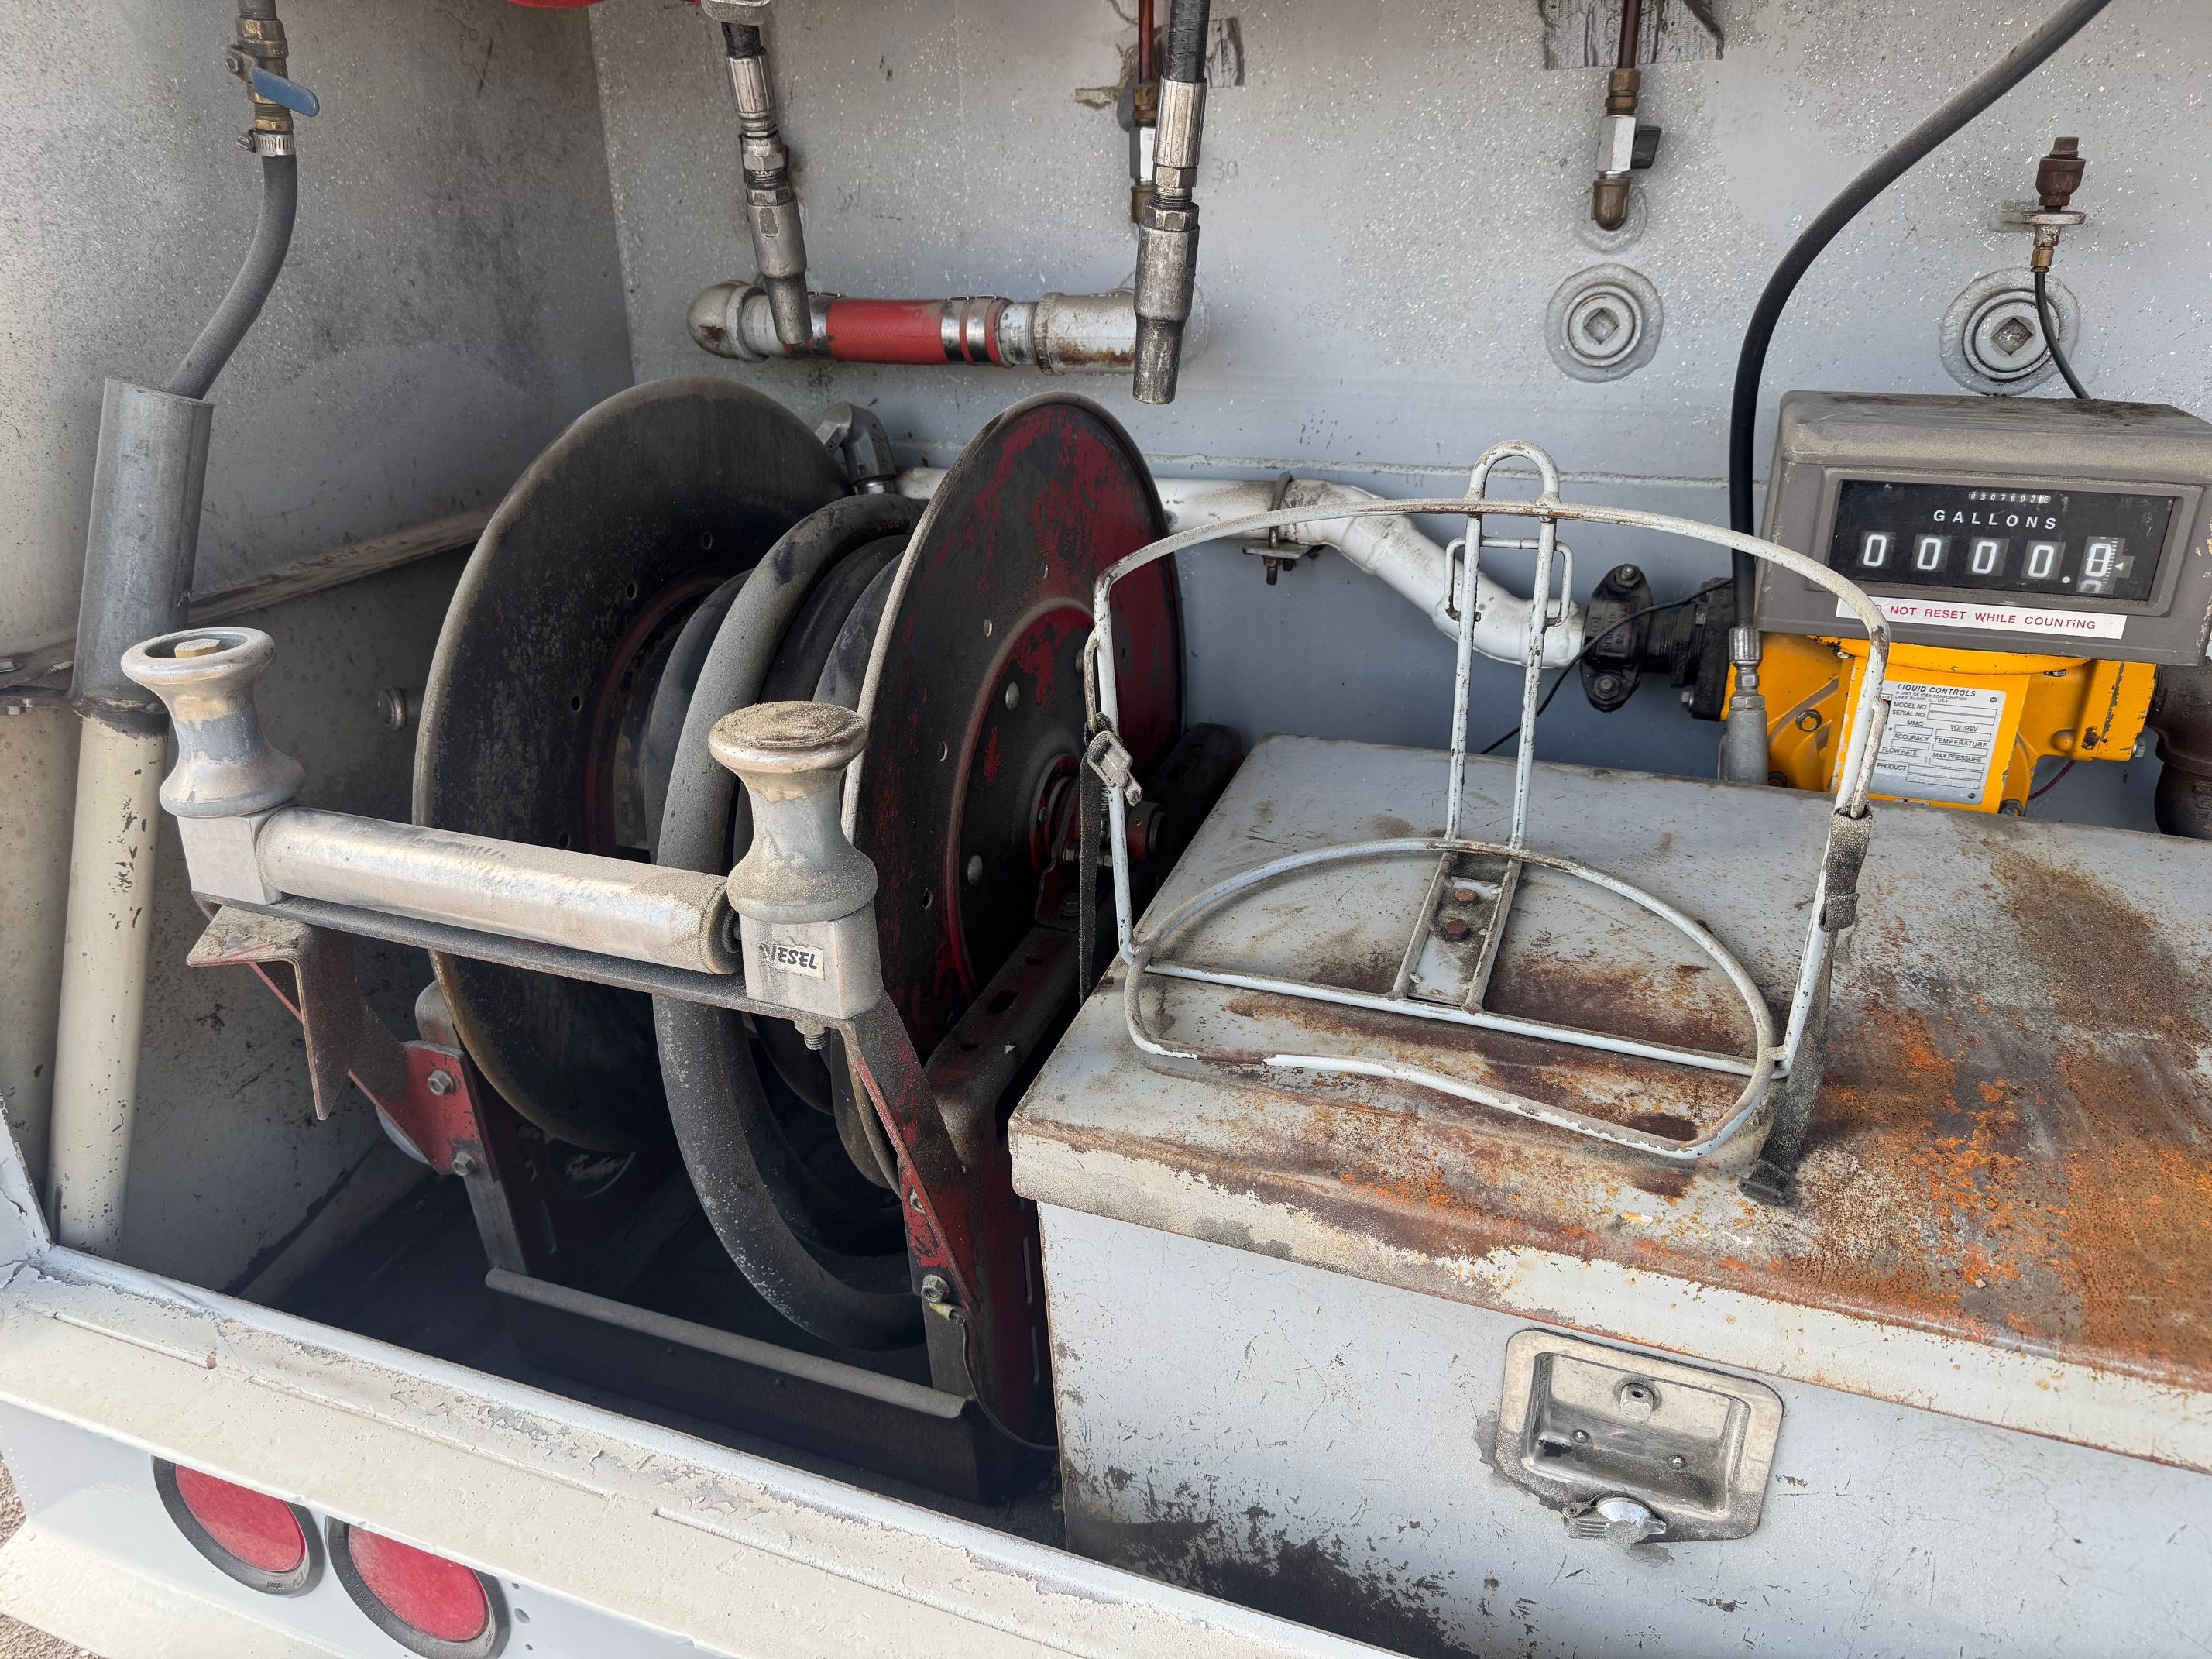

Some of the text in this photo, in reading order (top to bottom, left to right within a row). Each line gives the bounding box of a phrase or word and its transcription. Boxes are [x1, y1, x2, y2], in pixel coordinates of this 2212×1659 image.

[1211, 158, 1238, 182] 30
[1933, 510, 2057, 530] GALLONS
[1890, 606, 1917, 616] NOT
[1924, 608, 1967, 620] RESET
[1975, 612, 2017, 623] WHILE
[1897, 683, 1977, 697] LIQUID CONTROLS
[1893, 733, 1929, 742] ACCURACY
[1935, 737, 1987, 748] TEMPERATURE
[1948, 754, 1983, 763] PRESSURE
[1876, 762, 1907, 771] PRODUCT
